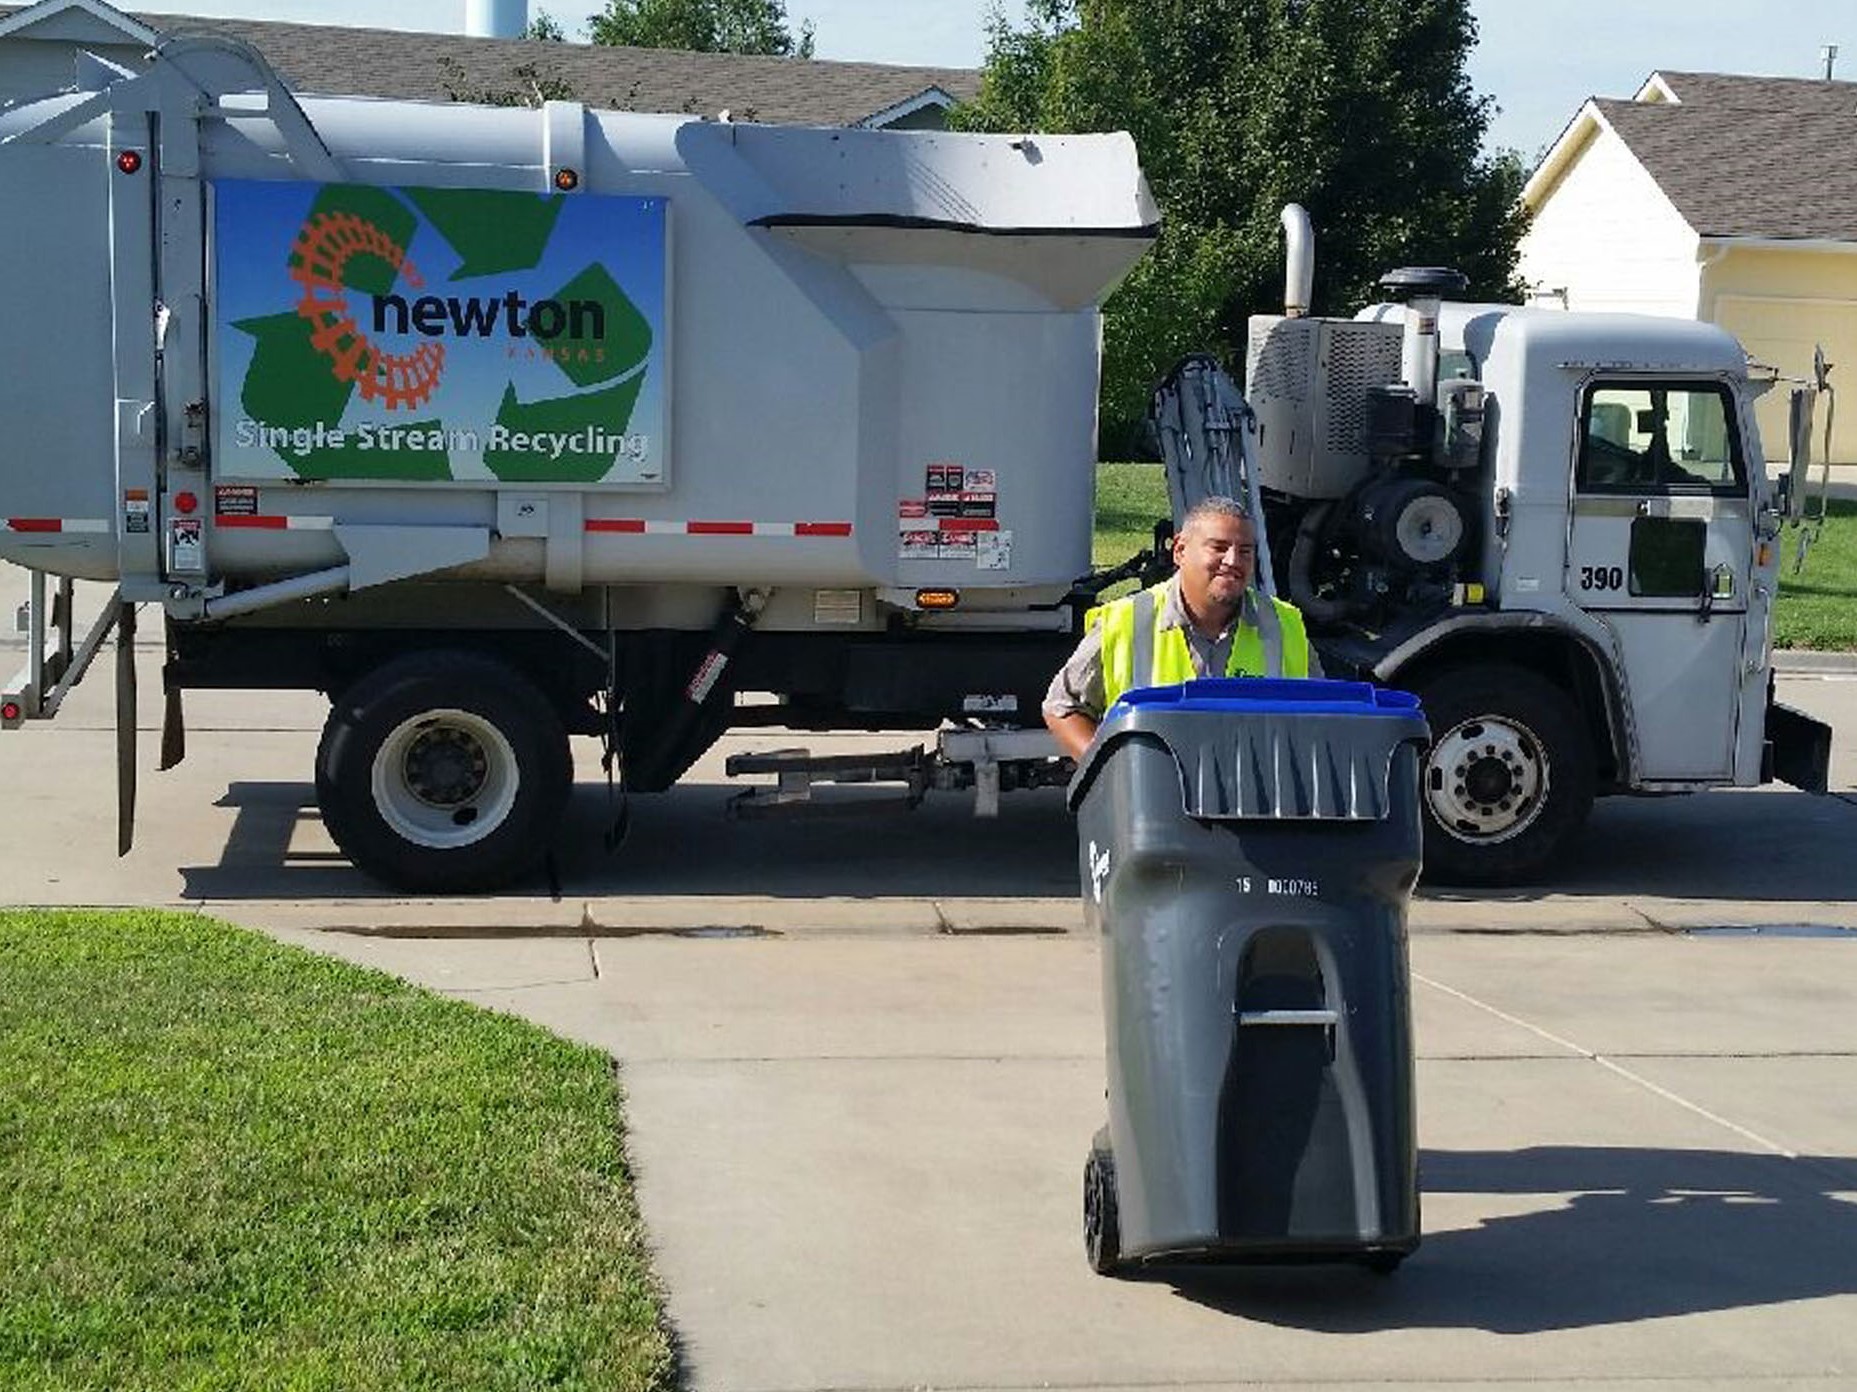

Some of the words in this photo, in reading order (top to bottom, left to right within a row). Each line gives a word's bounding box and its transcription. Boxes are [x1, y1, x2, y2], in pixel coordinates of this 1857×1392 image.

[372, 289, 604, 339] newton
[508, 347, 604, 363] KANSAS
[235, 420, 345, 456] Single
[357, 420, 478, 452] Stream
[491, 424, 649, 462] Recycling
[1581, 567, 1622, 590] 390
